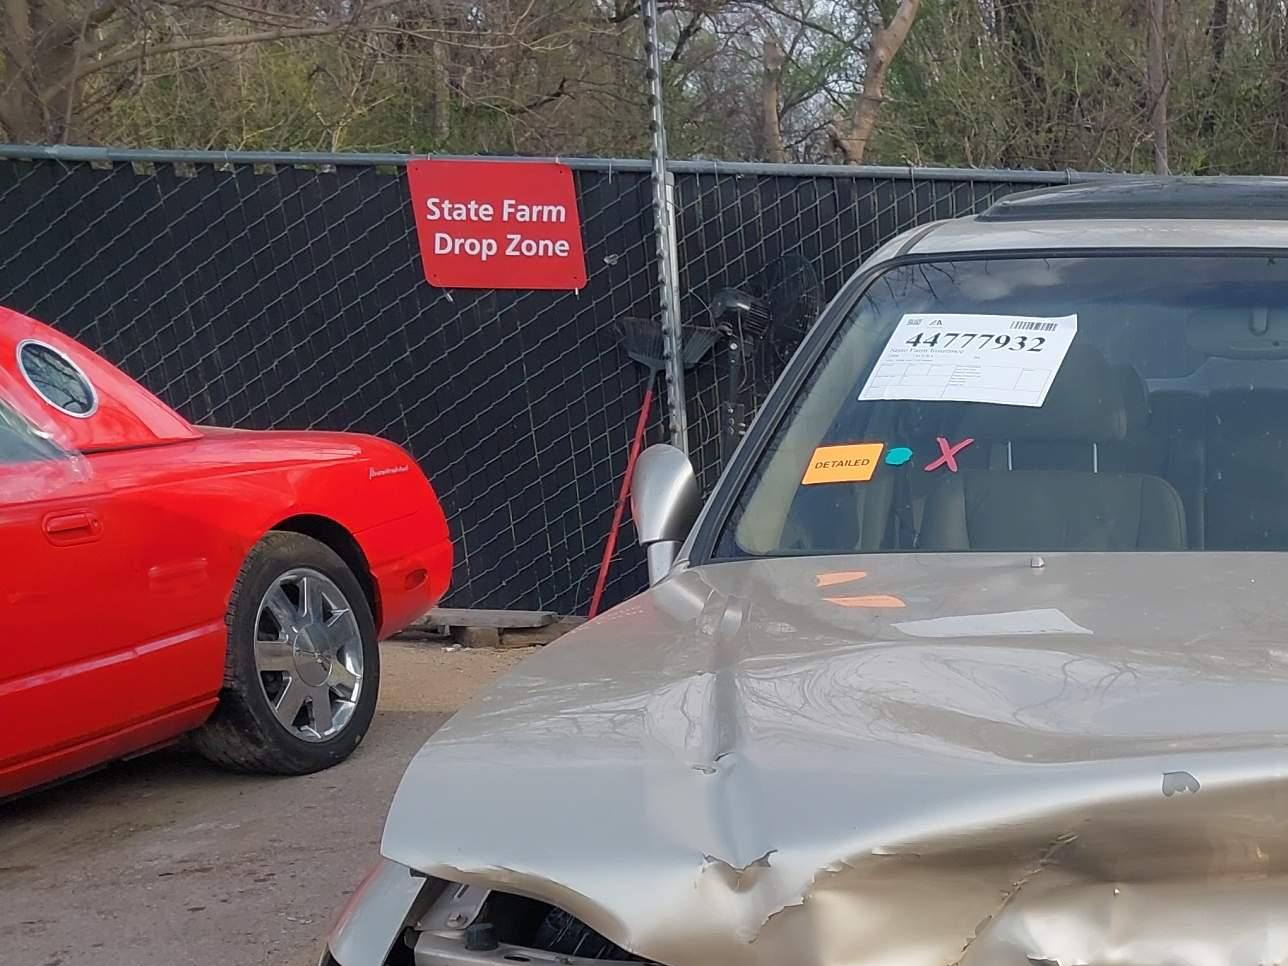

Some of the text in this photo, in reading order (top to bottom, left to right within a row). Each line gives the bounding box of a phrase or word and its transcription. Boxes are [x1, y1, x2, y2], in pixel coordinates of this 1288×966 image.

[426, 198, 566, 222] State Farm
[434, 233, 570, 261] Drop Zone
[905, 332, 1047, 352] 44777932
[814, 458, 871, 469] DETAILED
